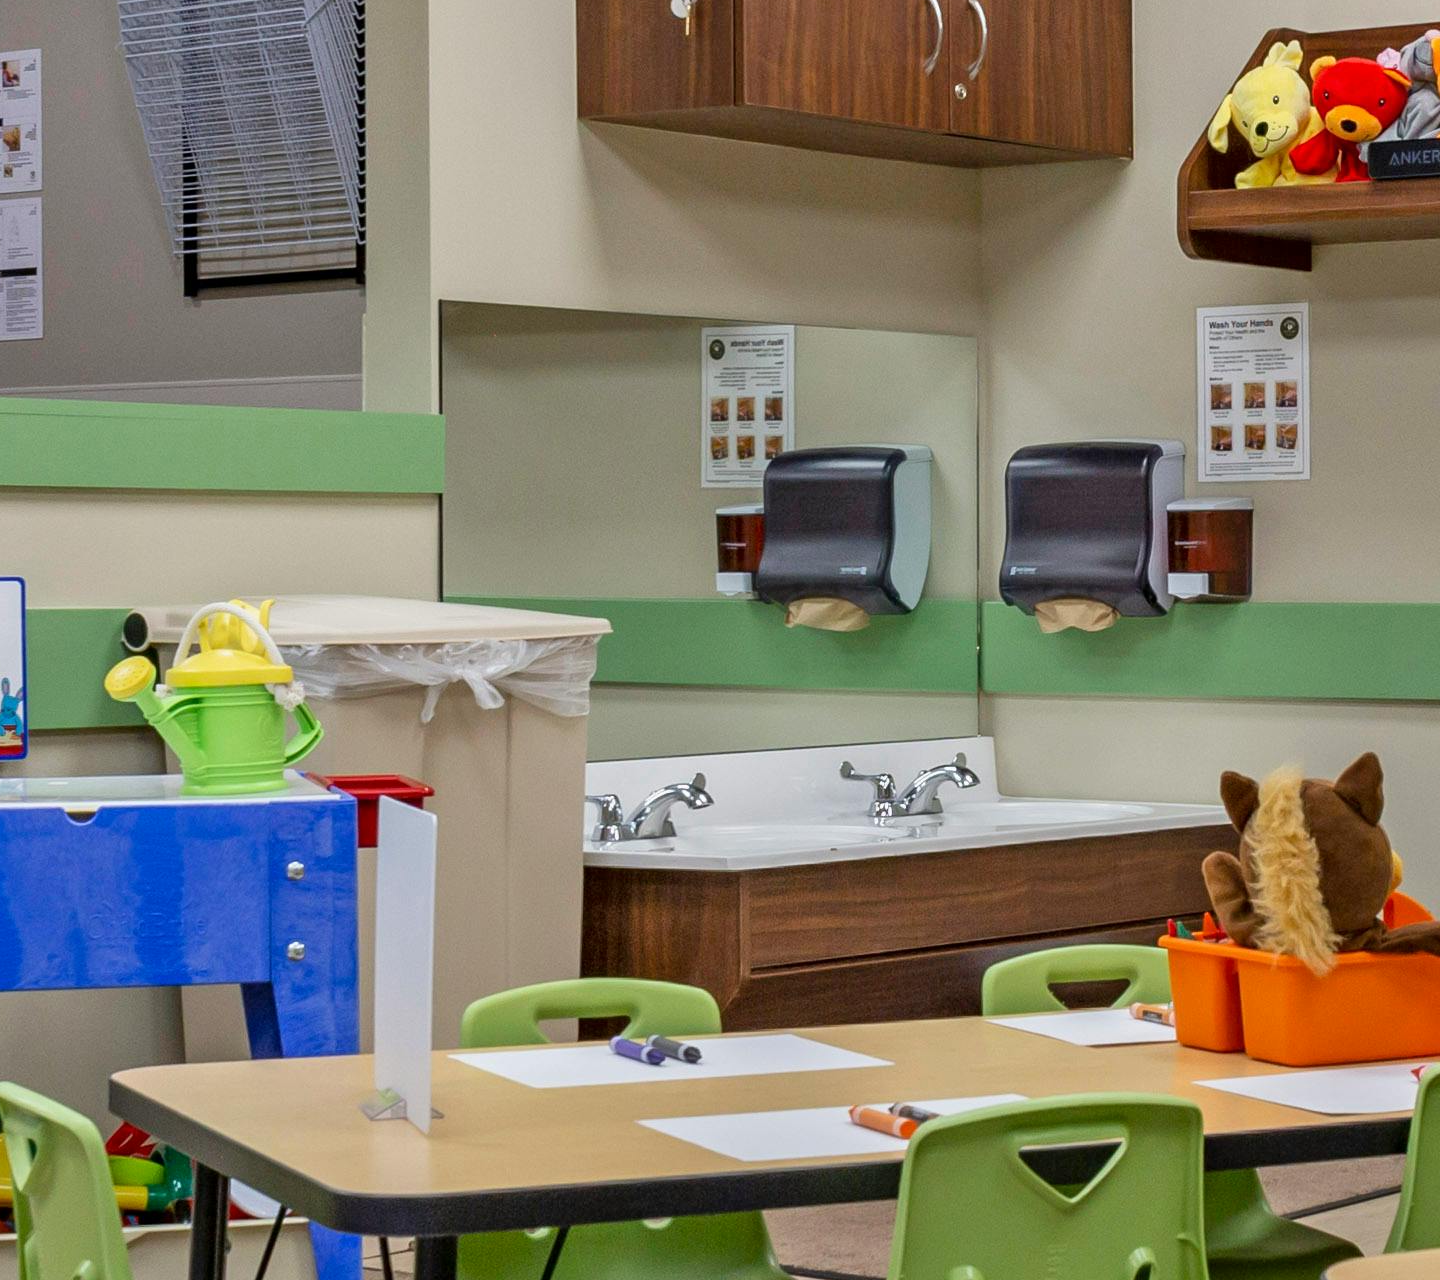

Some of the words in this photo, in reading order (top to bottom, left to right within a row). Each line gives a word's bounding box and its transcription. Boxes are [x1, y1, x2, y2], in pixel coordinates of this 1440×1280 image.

[1389, 150, 1440, 165] ANKER
[1209, 321, 1229, 329] Wash
[1231, 320, 1248, 328] Your
[1250, 319, 1273, 327] Hands
